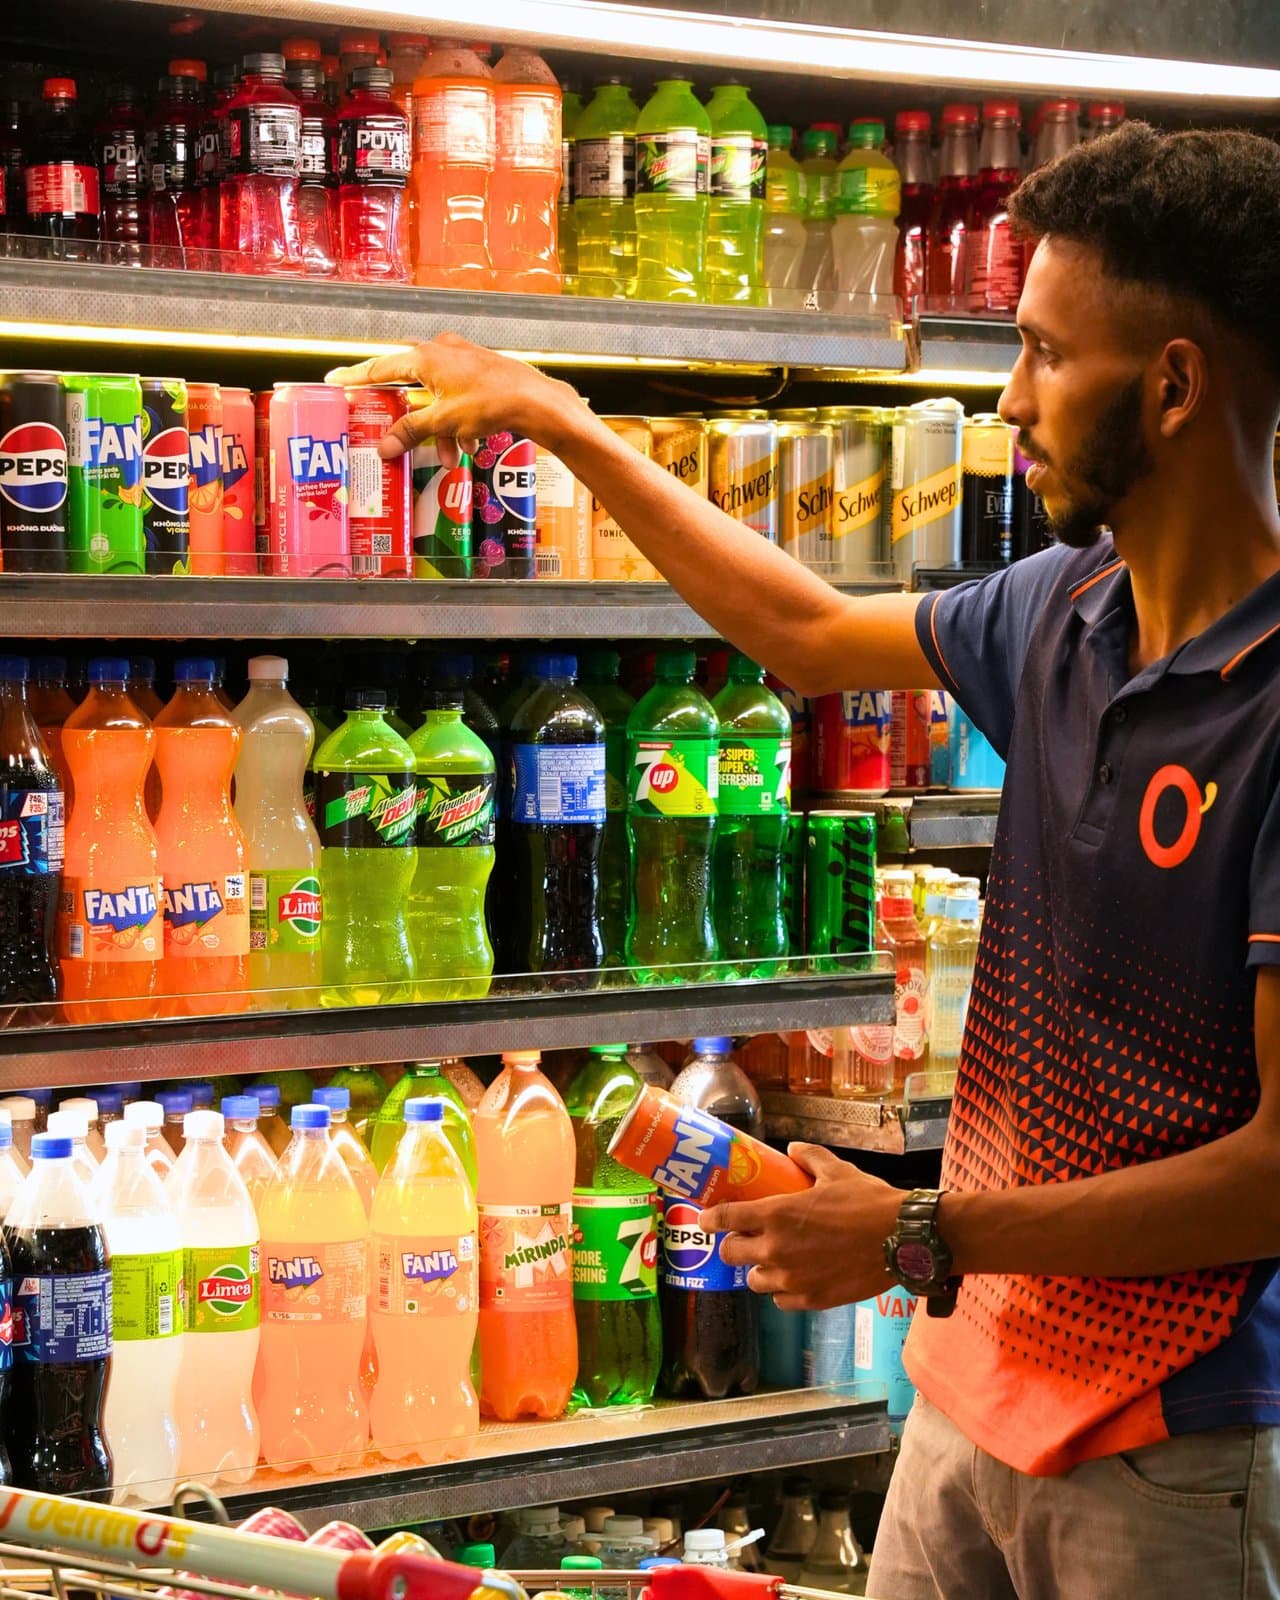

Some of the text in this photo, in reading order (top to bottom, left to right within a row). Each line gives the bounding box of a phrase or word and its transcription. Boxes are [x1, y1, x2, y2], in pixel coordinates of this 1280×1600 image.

[279, 484, 289, 573] RECYCLE ME
[726, 748, 755, 761] SUPER
[84, 886, 157, 921] FANTA
[664, 1228, 711, 1246] PEPSI
[269, 1257, 323, 1280] FANTA
[402, 1250, 458, 1275] FANTA
[201, 1281, 251, 1298] Limca
[686, 1277, 705, 1289] FIZZ
